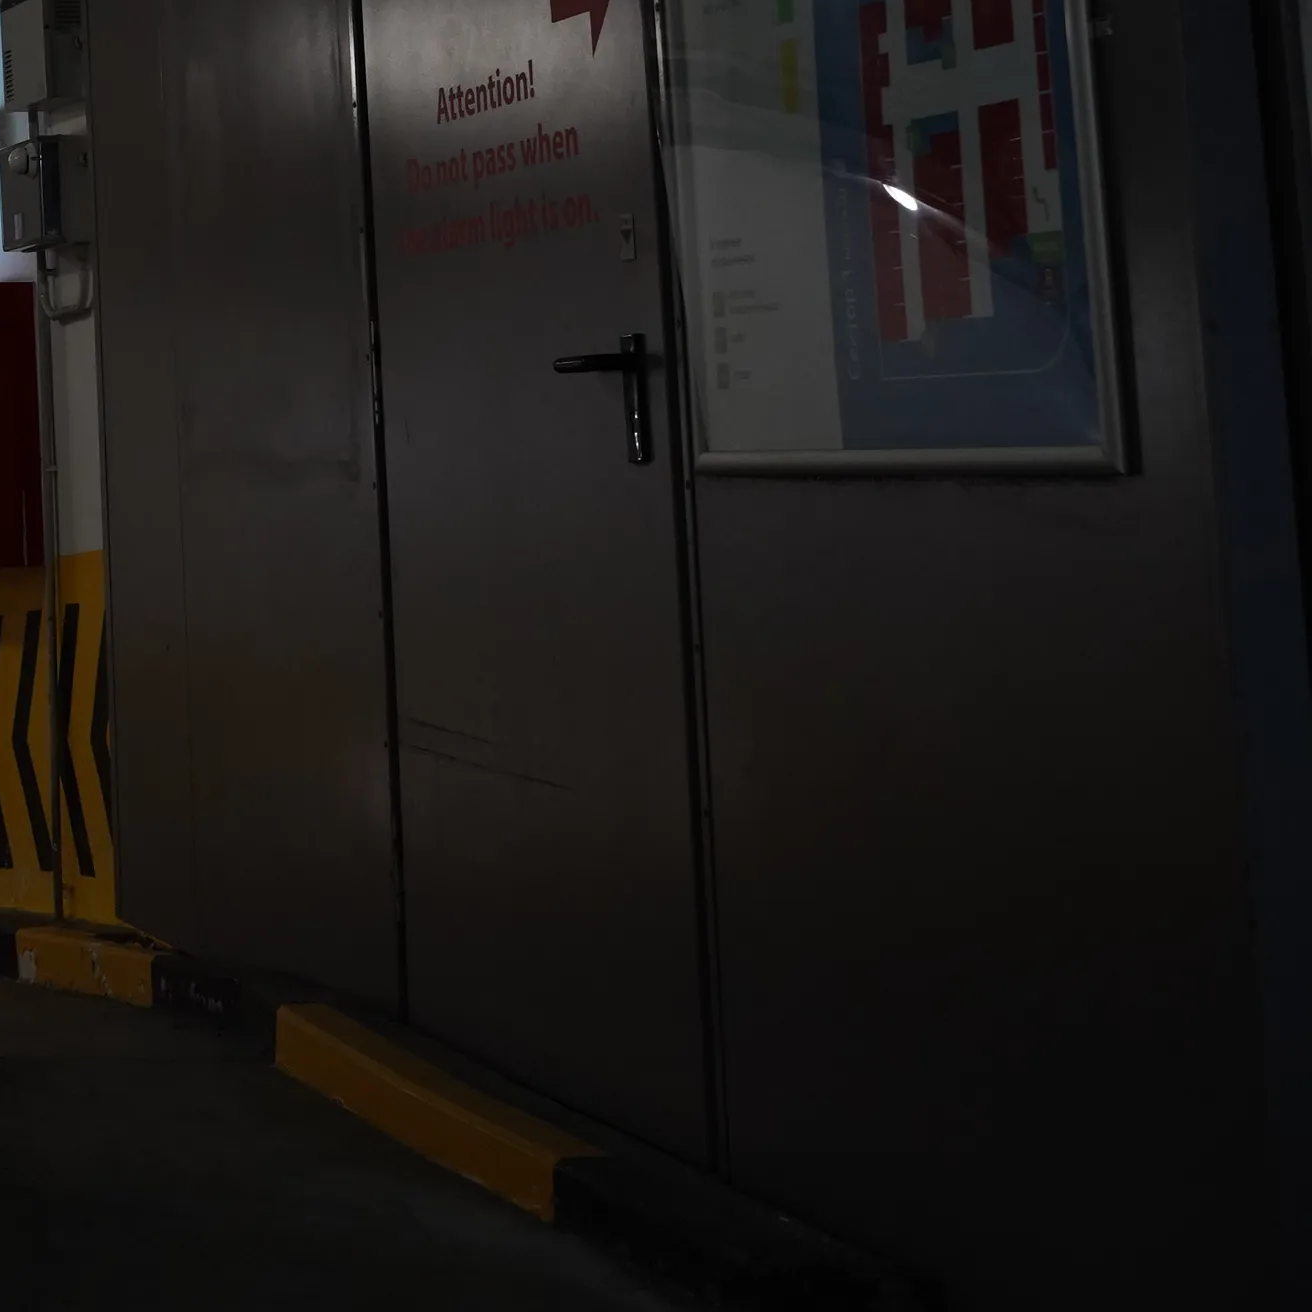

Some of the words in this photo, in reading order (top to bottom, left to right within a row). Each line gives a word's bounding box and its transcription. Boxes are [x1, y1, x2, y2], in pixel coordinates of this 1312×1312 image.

[437, 59, 535, 124] Attention!
[406, 157, 432, 193] Do
[436, 147, 468, 187] not
[473, 142, 516, 189] pass
[520, 122, 579, 167] when
[489, 195, 538, 248] light
[541, 191, 560, 230] is
[563, 194, 600, 228] on.
